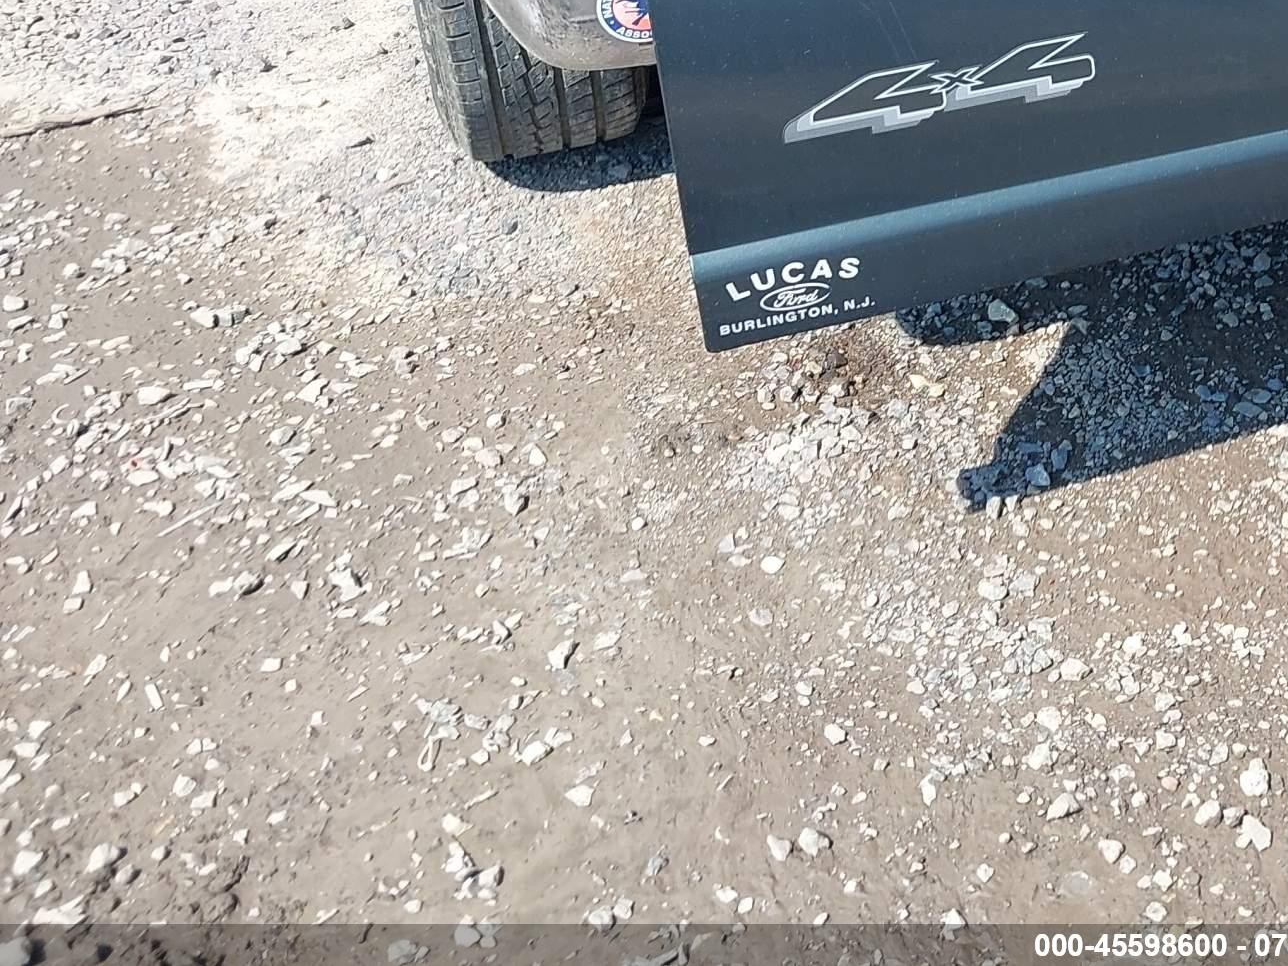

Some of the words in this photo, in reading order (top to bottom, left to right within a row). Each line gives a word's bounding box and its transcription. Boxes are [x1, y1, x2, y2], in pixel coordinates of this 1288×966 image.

[726, 257, 861, 302] LUCAS
[773, 288, 819, 308] Ford
[719, 303, 838, 337] BURLINGTON,
[843, 296, 876, 312] N.J.
